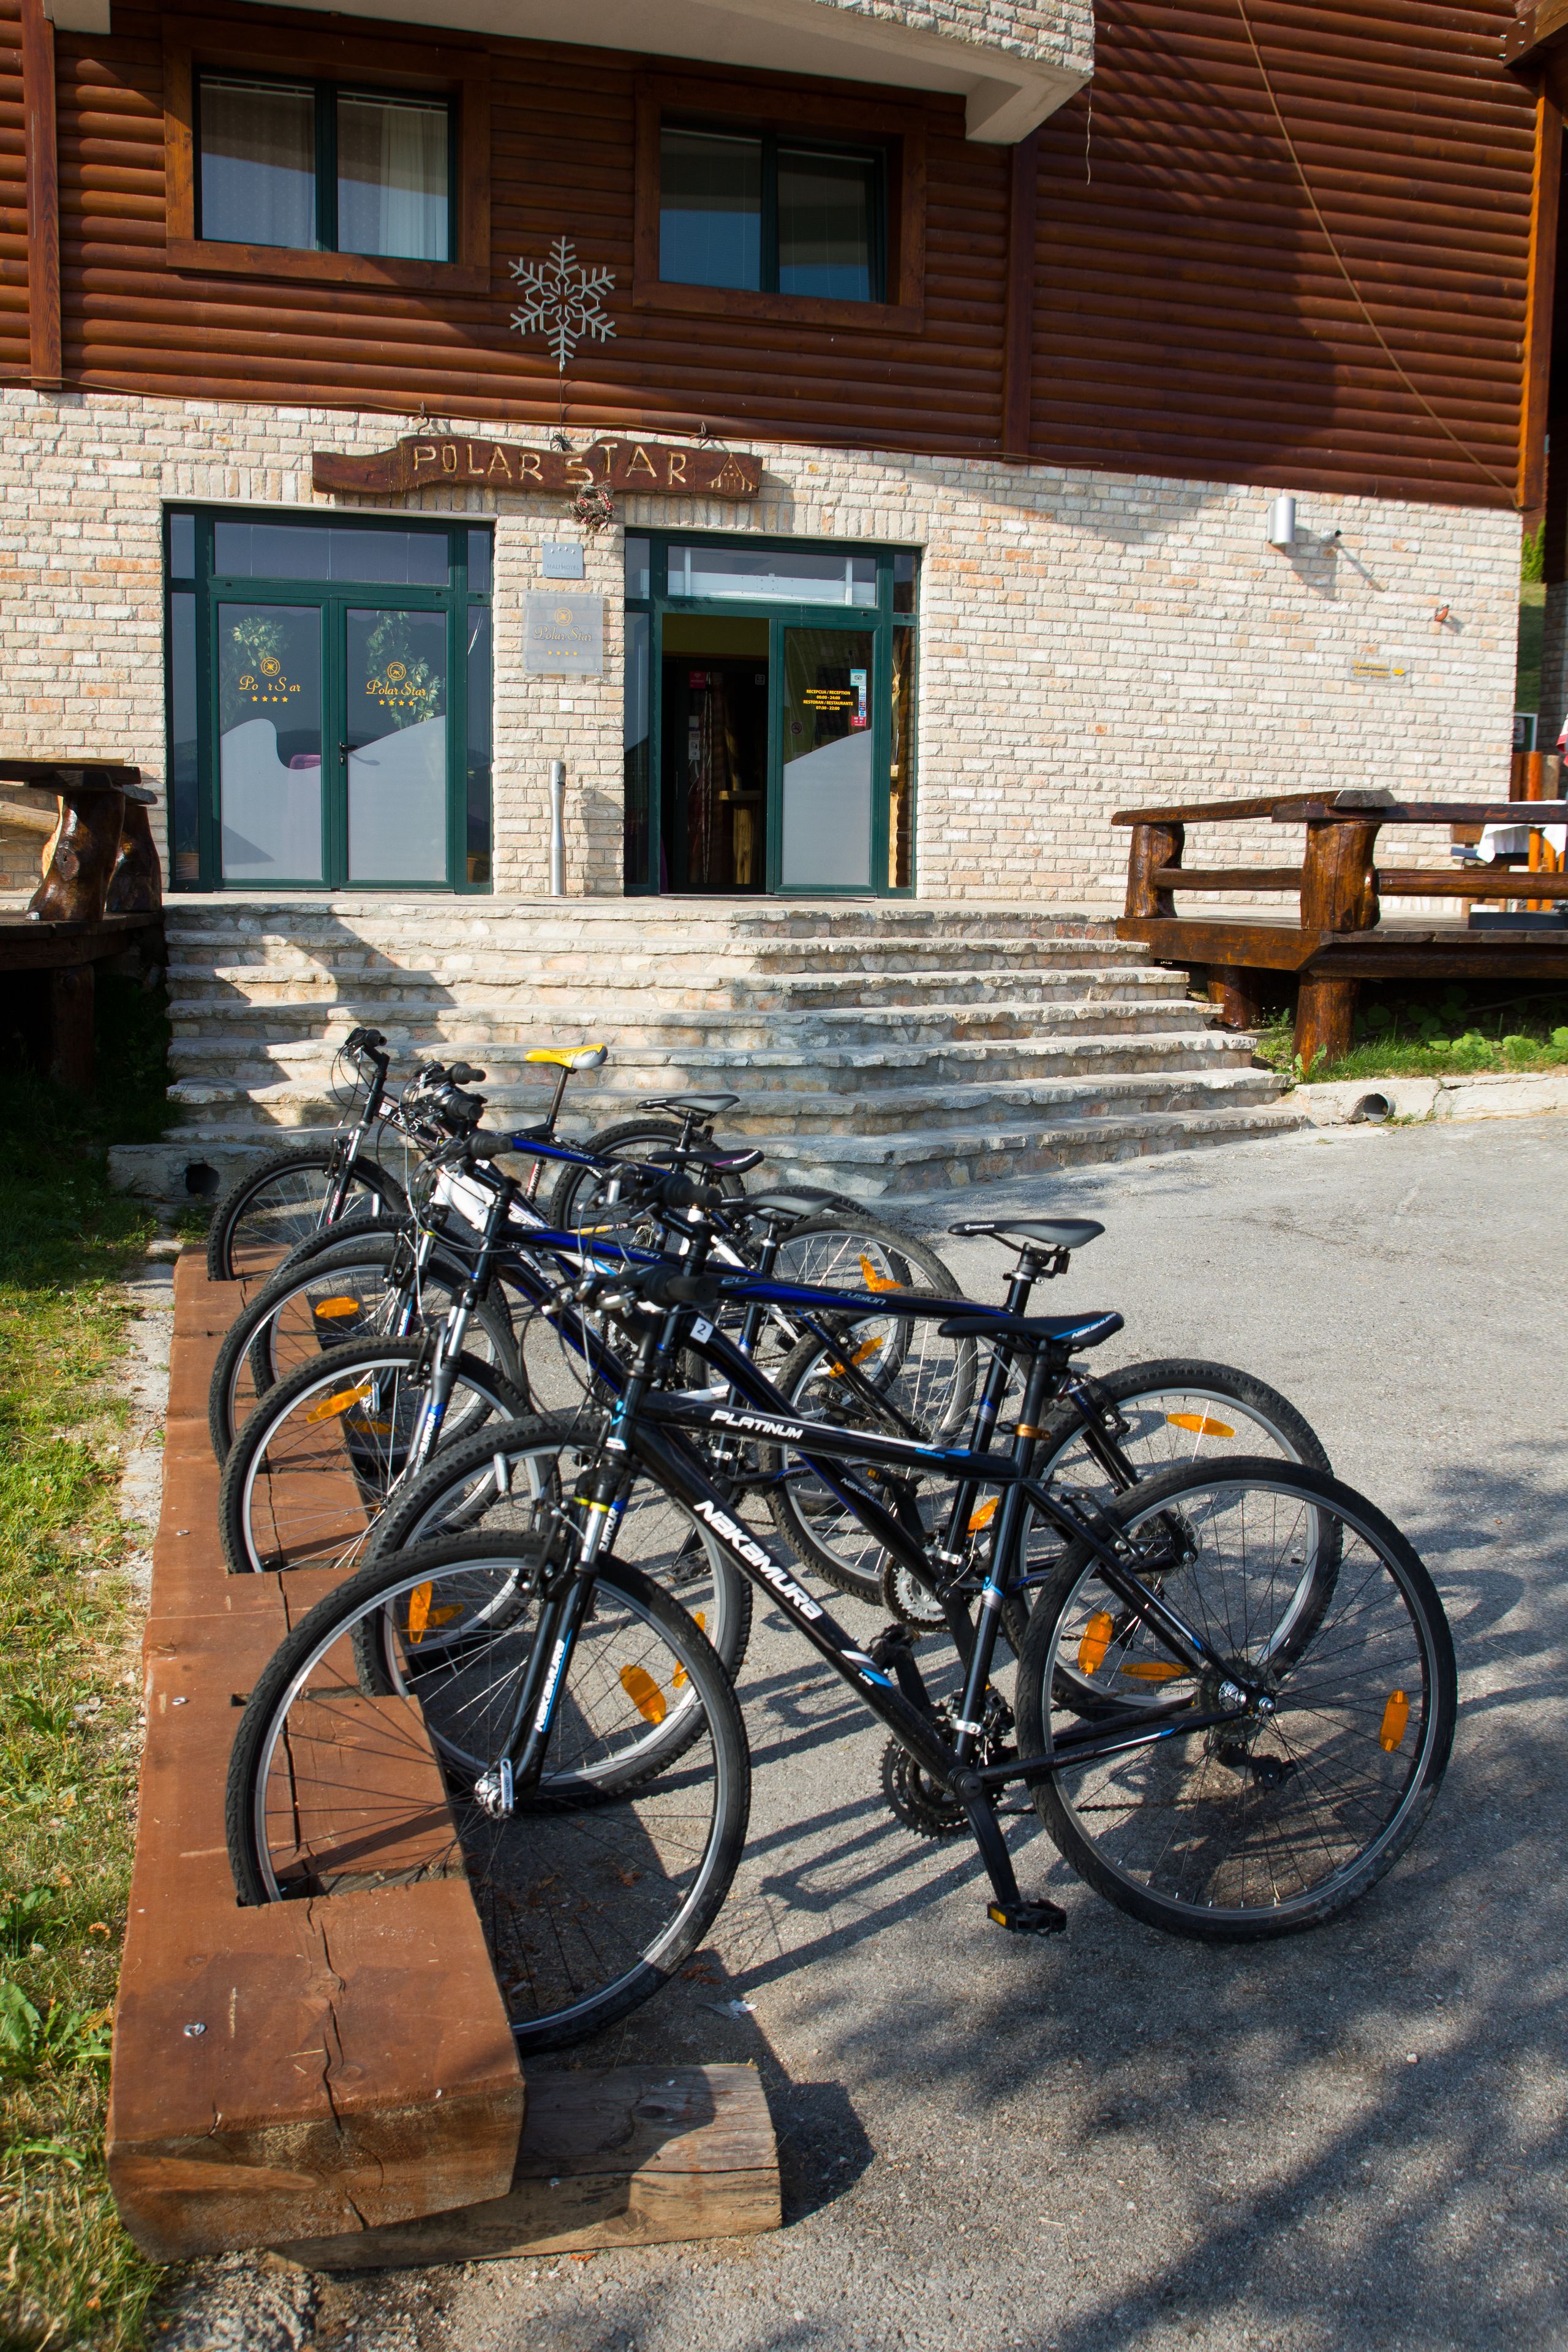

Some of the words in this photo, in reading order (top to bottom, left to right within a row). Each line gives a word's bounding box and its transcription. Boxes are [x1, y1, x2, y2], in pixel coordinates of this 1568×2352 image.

[414, 443, 543, 481] POLAR
[564, 443, 687, 485] STAR
[533, 625, 565, 641] Polar
[567, 627, 592, 641] Star
[366, 680, 398, 696] Polar
[401, 681, 426, 697] Star
[697, 1323, 707, 1335] 2
[710, 1409, 804, 1439] PLATINUM
